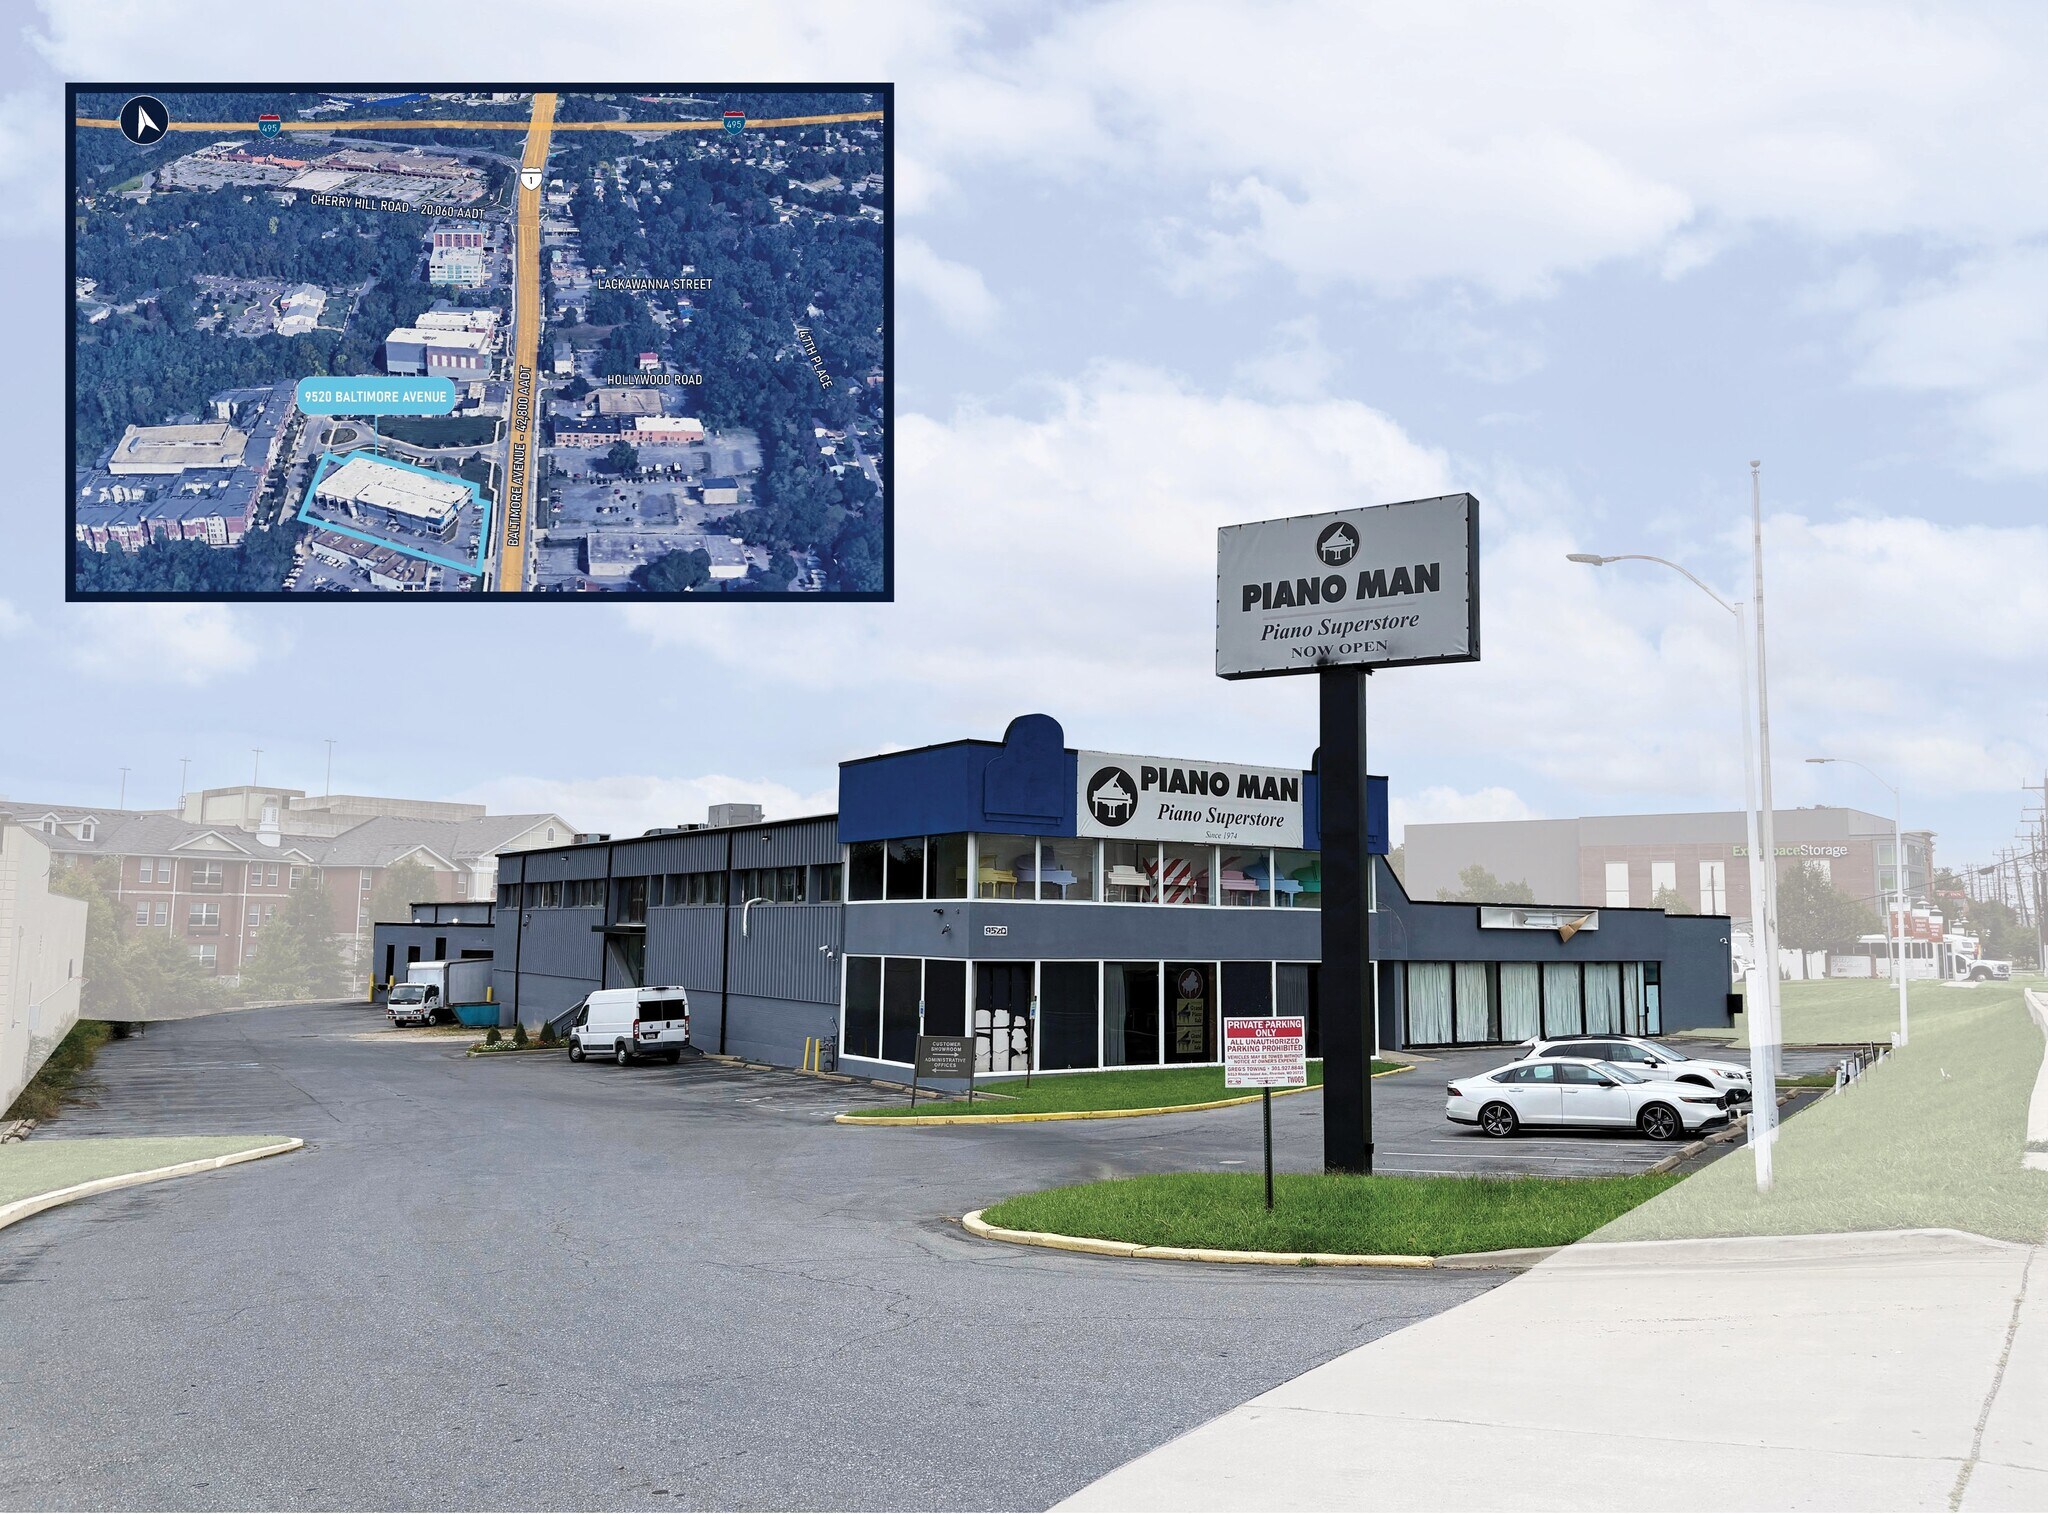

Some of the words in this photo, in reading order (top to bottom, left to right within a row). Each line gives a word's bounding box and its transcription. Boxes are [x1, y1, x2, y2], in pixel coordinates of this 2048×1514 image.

[1242, 574, 1347, 612] PIANO
[1356, 562, 1440, 600] MAN
[1260, 623, 1313, 642] Piano
[1317, 613, 1420, 640] Superstore
[1291, 645, 1335, 658] NOW
[1338, 640, 1388, 655] OPEN
[1140, 765, 1230, 797] PIANO
[1236, 774, 1299, 802] MAN
[1157, 803, 1202, 823] Piano
[1205, 806, 1284, 829] Superstore
[1205, 831, 1222, 839] Since
[1224, 831, 1238, 840] 1974
[985, 926, 1007, 935] 9520
[1228, 1020, 1264, 1029] PRIVATE
[1265, 1020, 1301, 1028] PARKING
[1255, 1029, 1277, 1037] ONLY
[1261, 1044, 1303, 1052] PROHIBITED
